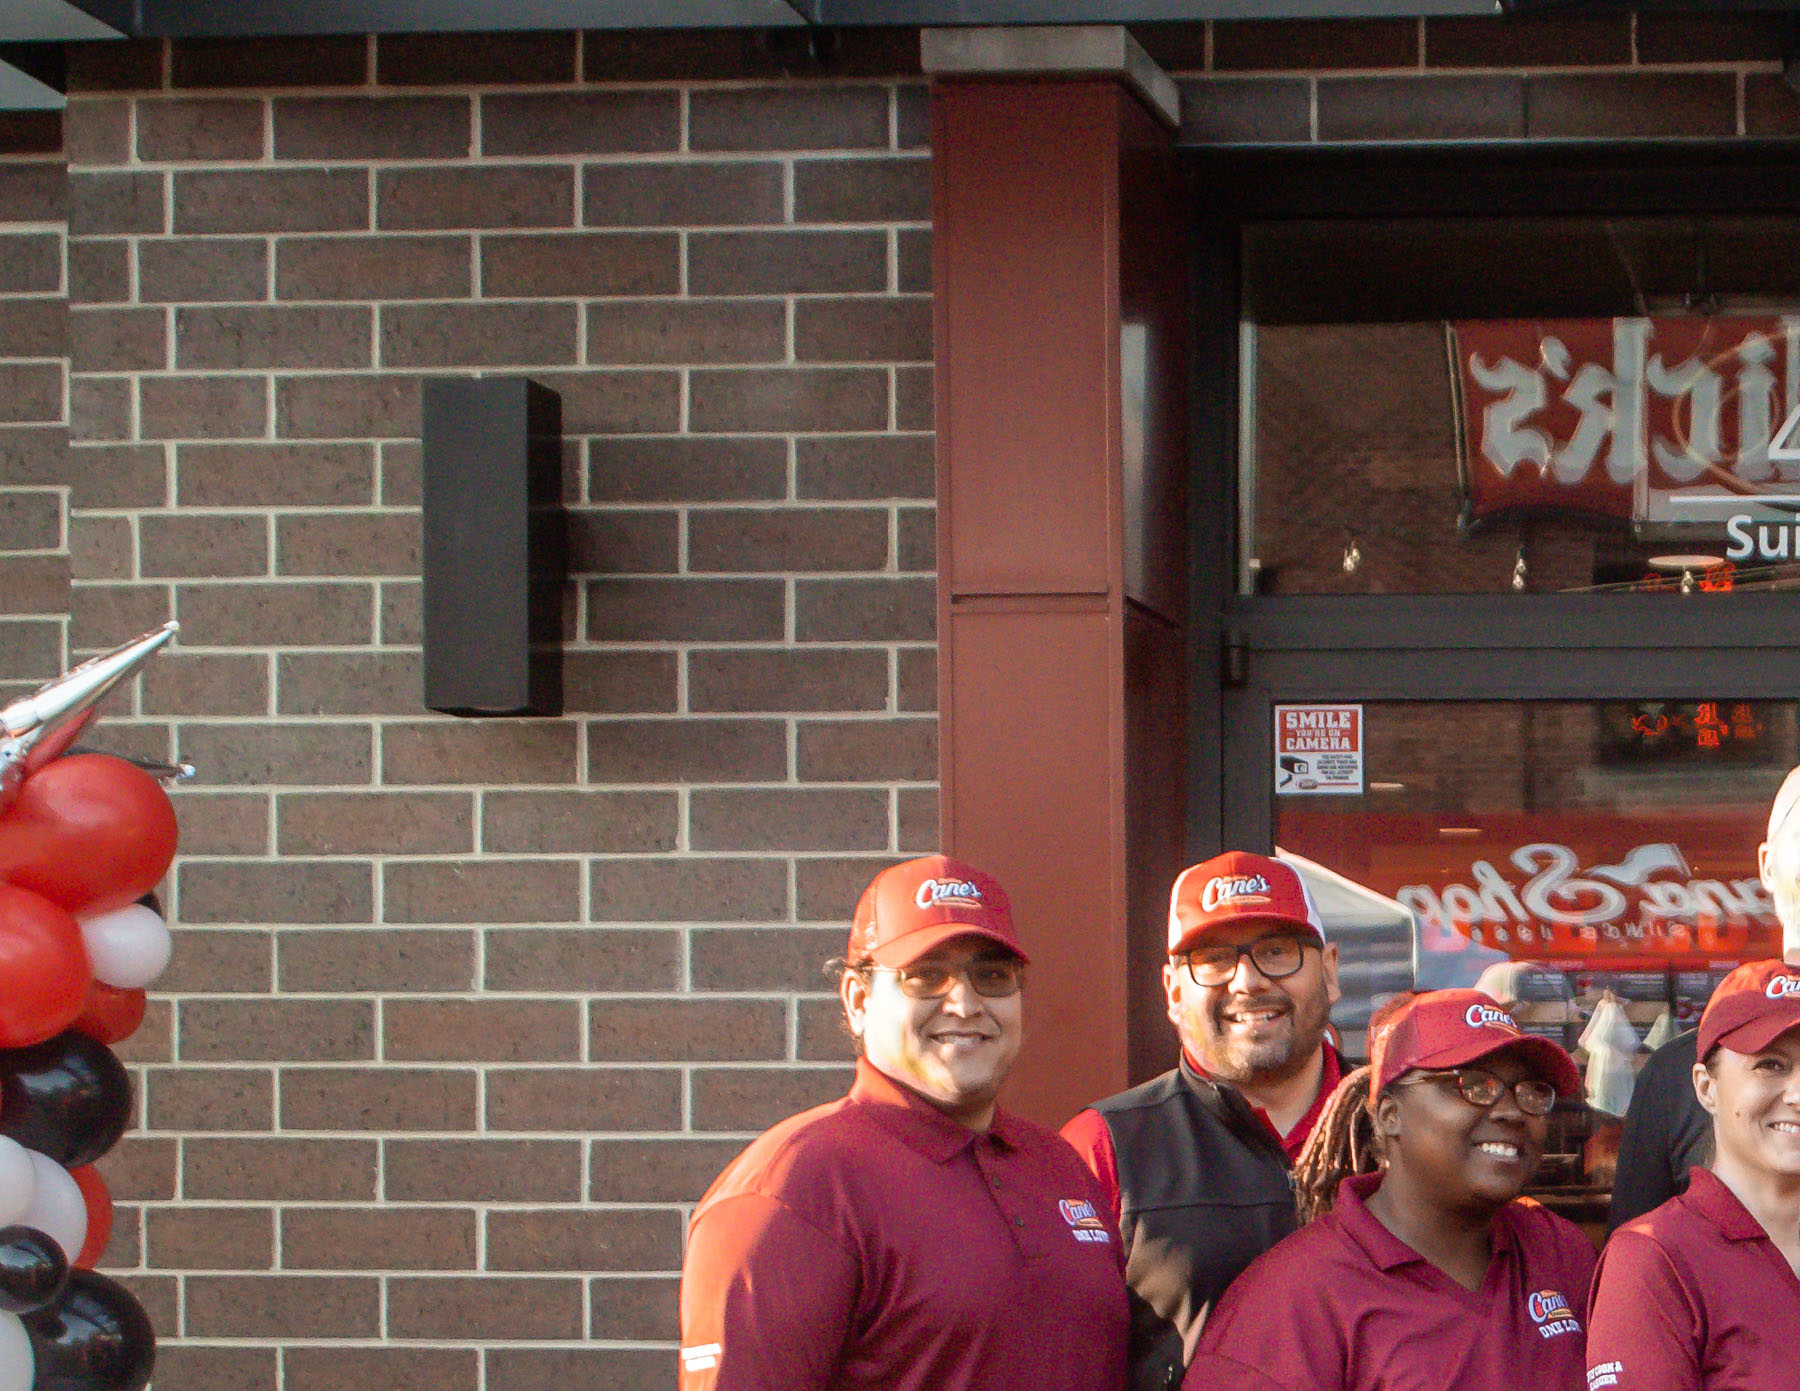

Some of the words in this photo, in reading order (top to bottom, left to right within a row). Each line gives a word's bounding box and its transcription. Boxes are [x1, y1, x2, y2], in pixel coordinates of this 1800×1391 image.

[1286, 711, 1351, 729] SMILE
[1296, 728, 1326, 737] YOU'RE
[1329, 728, 1341, 737] ON
[1286, 736, 1351, 751] CAMERA
[916, 879, 982, 909] Cane's
[1201, 874, 1271, 912] Cane's
[1539, 1321, 1565, 1339] ONE
